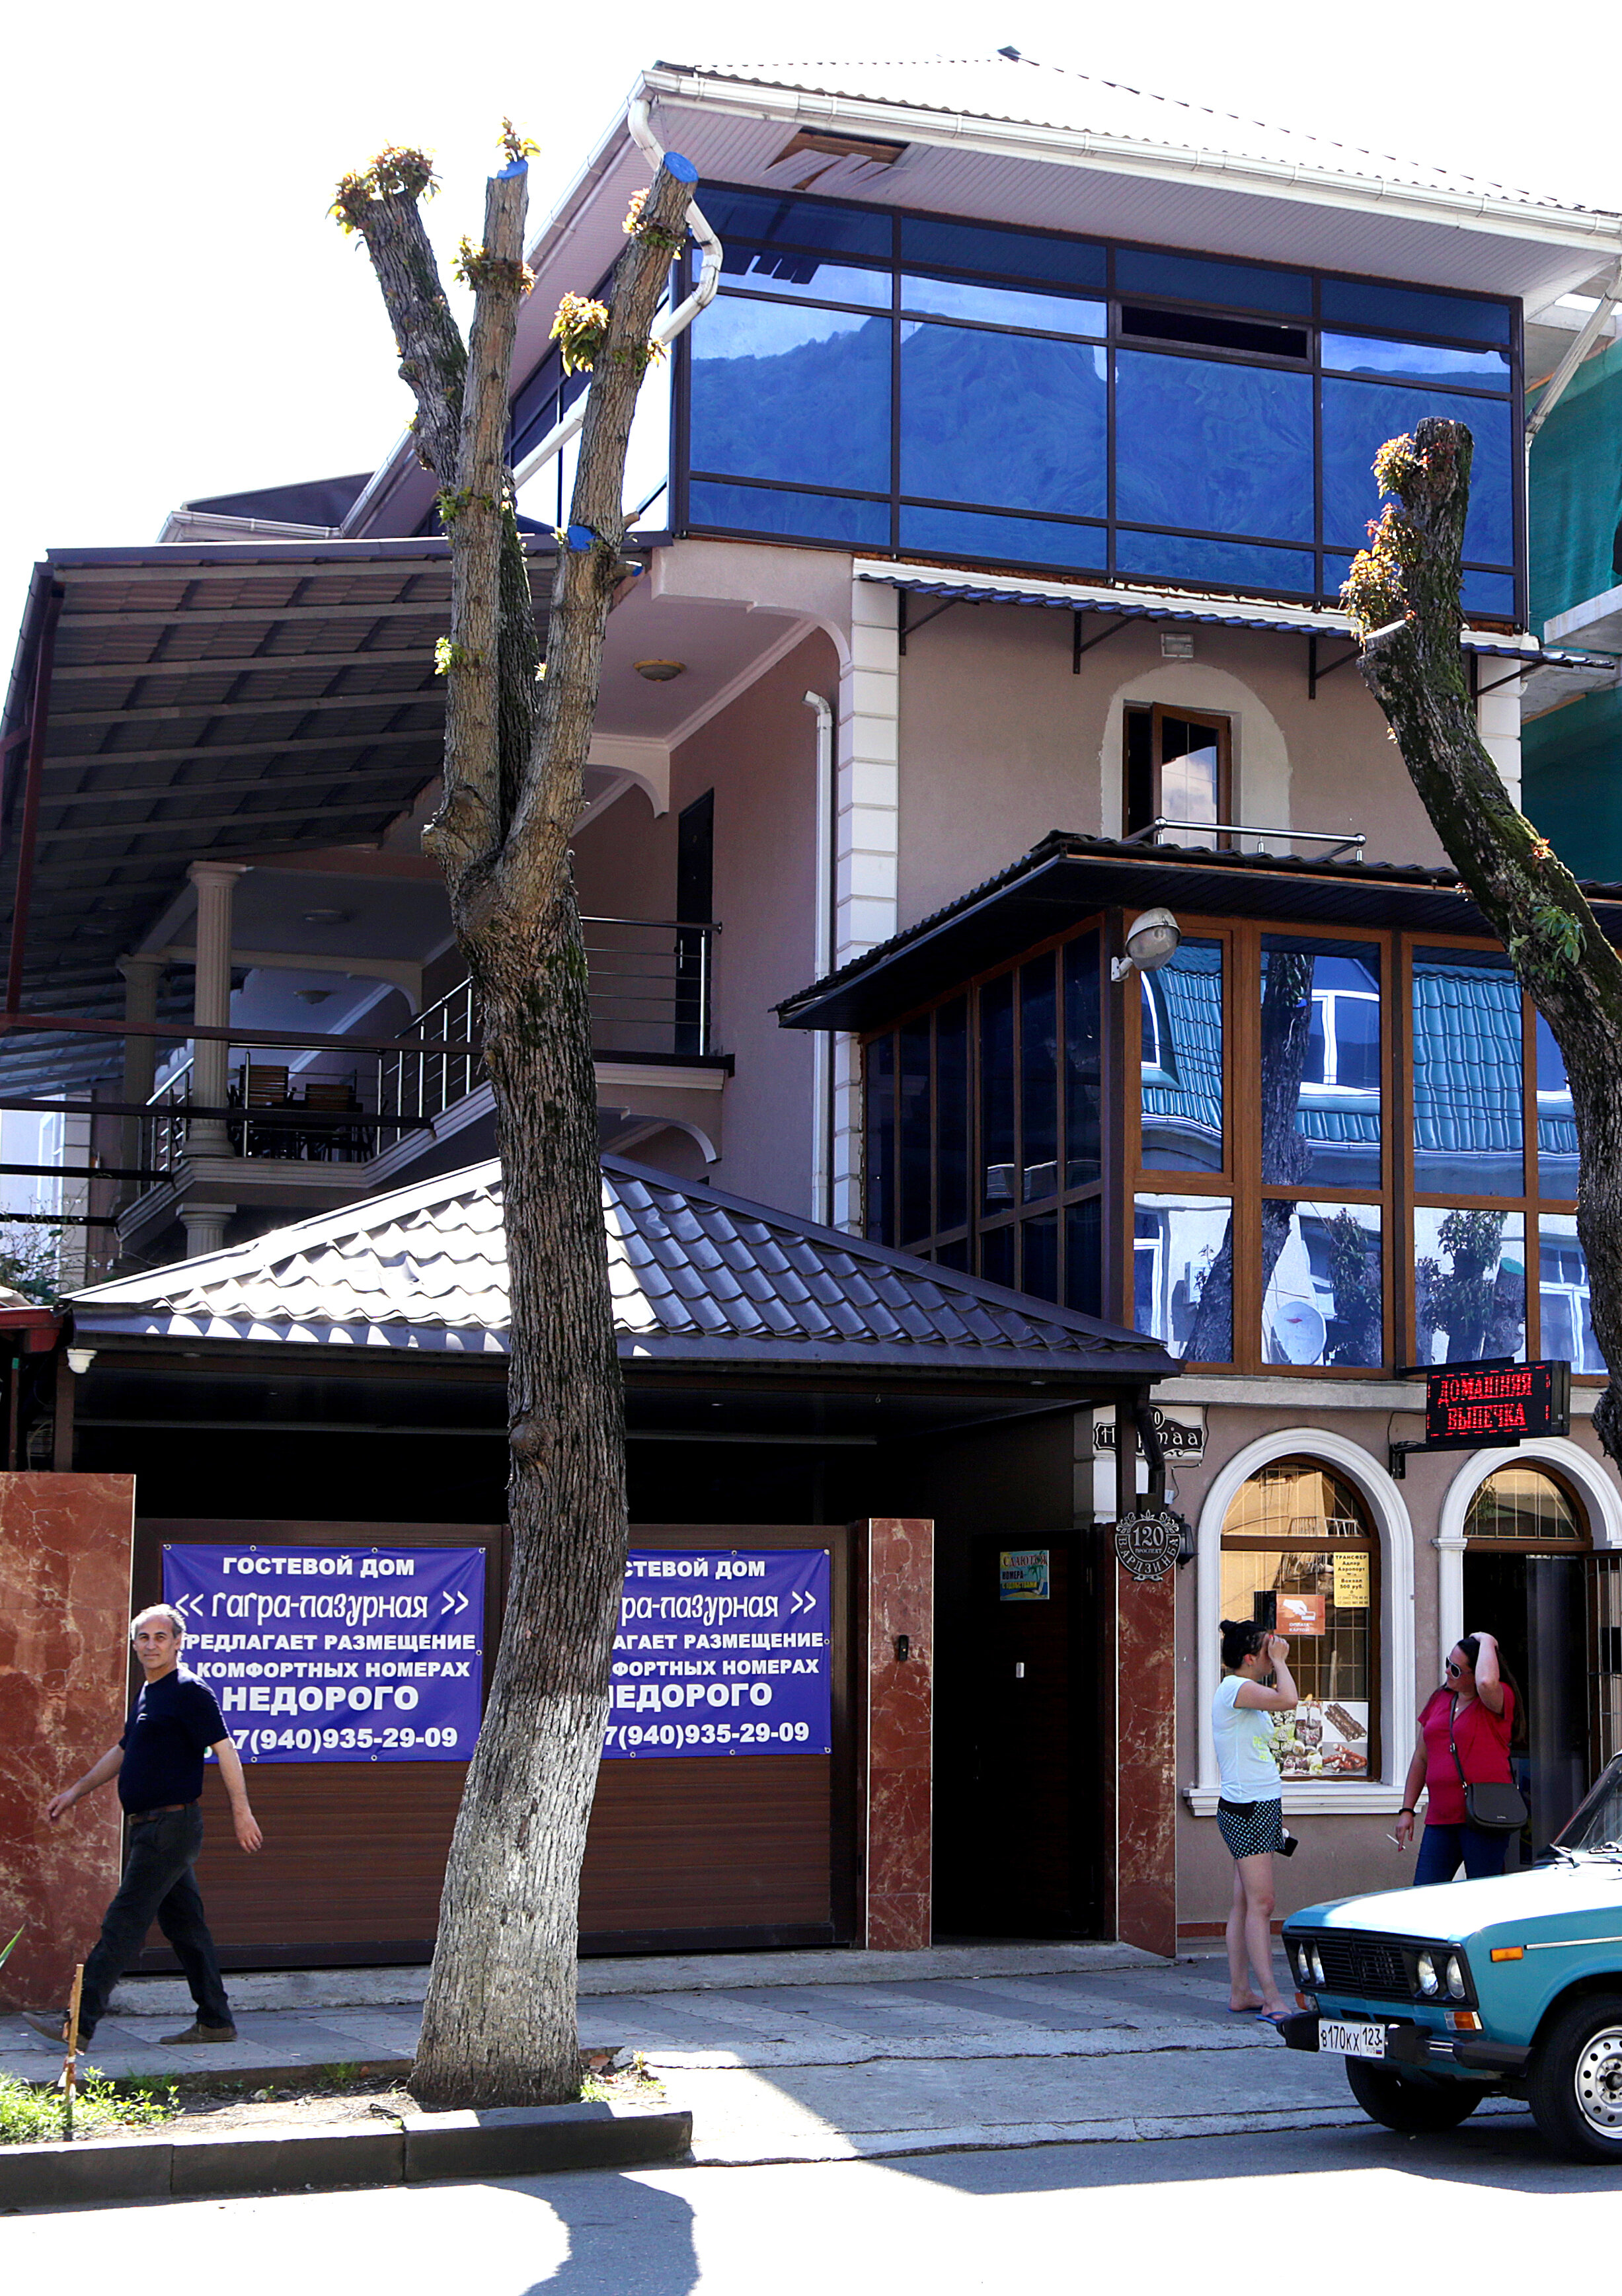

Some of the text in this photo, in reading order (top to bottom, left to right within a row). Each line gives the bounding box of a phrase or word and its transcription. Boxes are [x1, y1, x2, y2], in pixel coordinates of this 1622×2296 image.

[1448, 1403, 1526, 1430] ВЫПЕЧКА
[1133, 1526, 1164, 1546] 120
[223, 1555, 414, 1578] ГОСТЕВОЙ ДОМ
[625, 1558, 765, 1579] СТЕВОЙ ДОМ
[622, 1594, 779, 1626] ра-лазурная
[325, 1635, 475, 1652] РАЗМЕЩЕНИЕ
[612, 1633, 823, 1650] АГАЕТ РАЗМЕЩЕНИЕ
[197, 1660, 359, 1678] КОМФОРТНЫХ
[366, 1662, 470, 1677] НОМЕРАХ
[612, 1659, 819, 1677] ФОРТНЫХ НОМЕРАХ
[221, 1686, 418, 1716] НЕДОРОГО
[1362, 2027, 1382, 2045] 123
